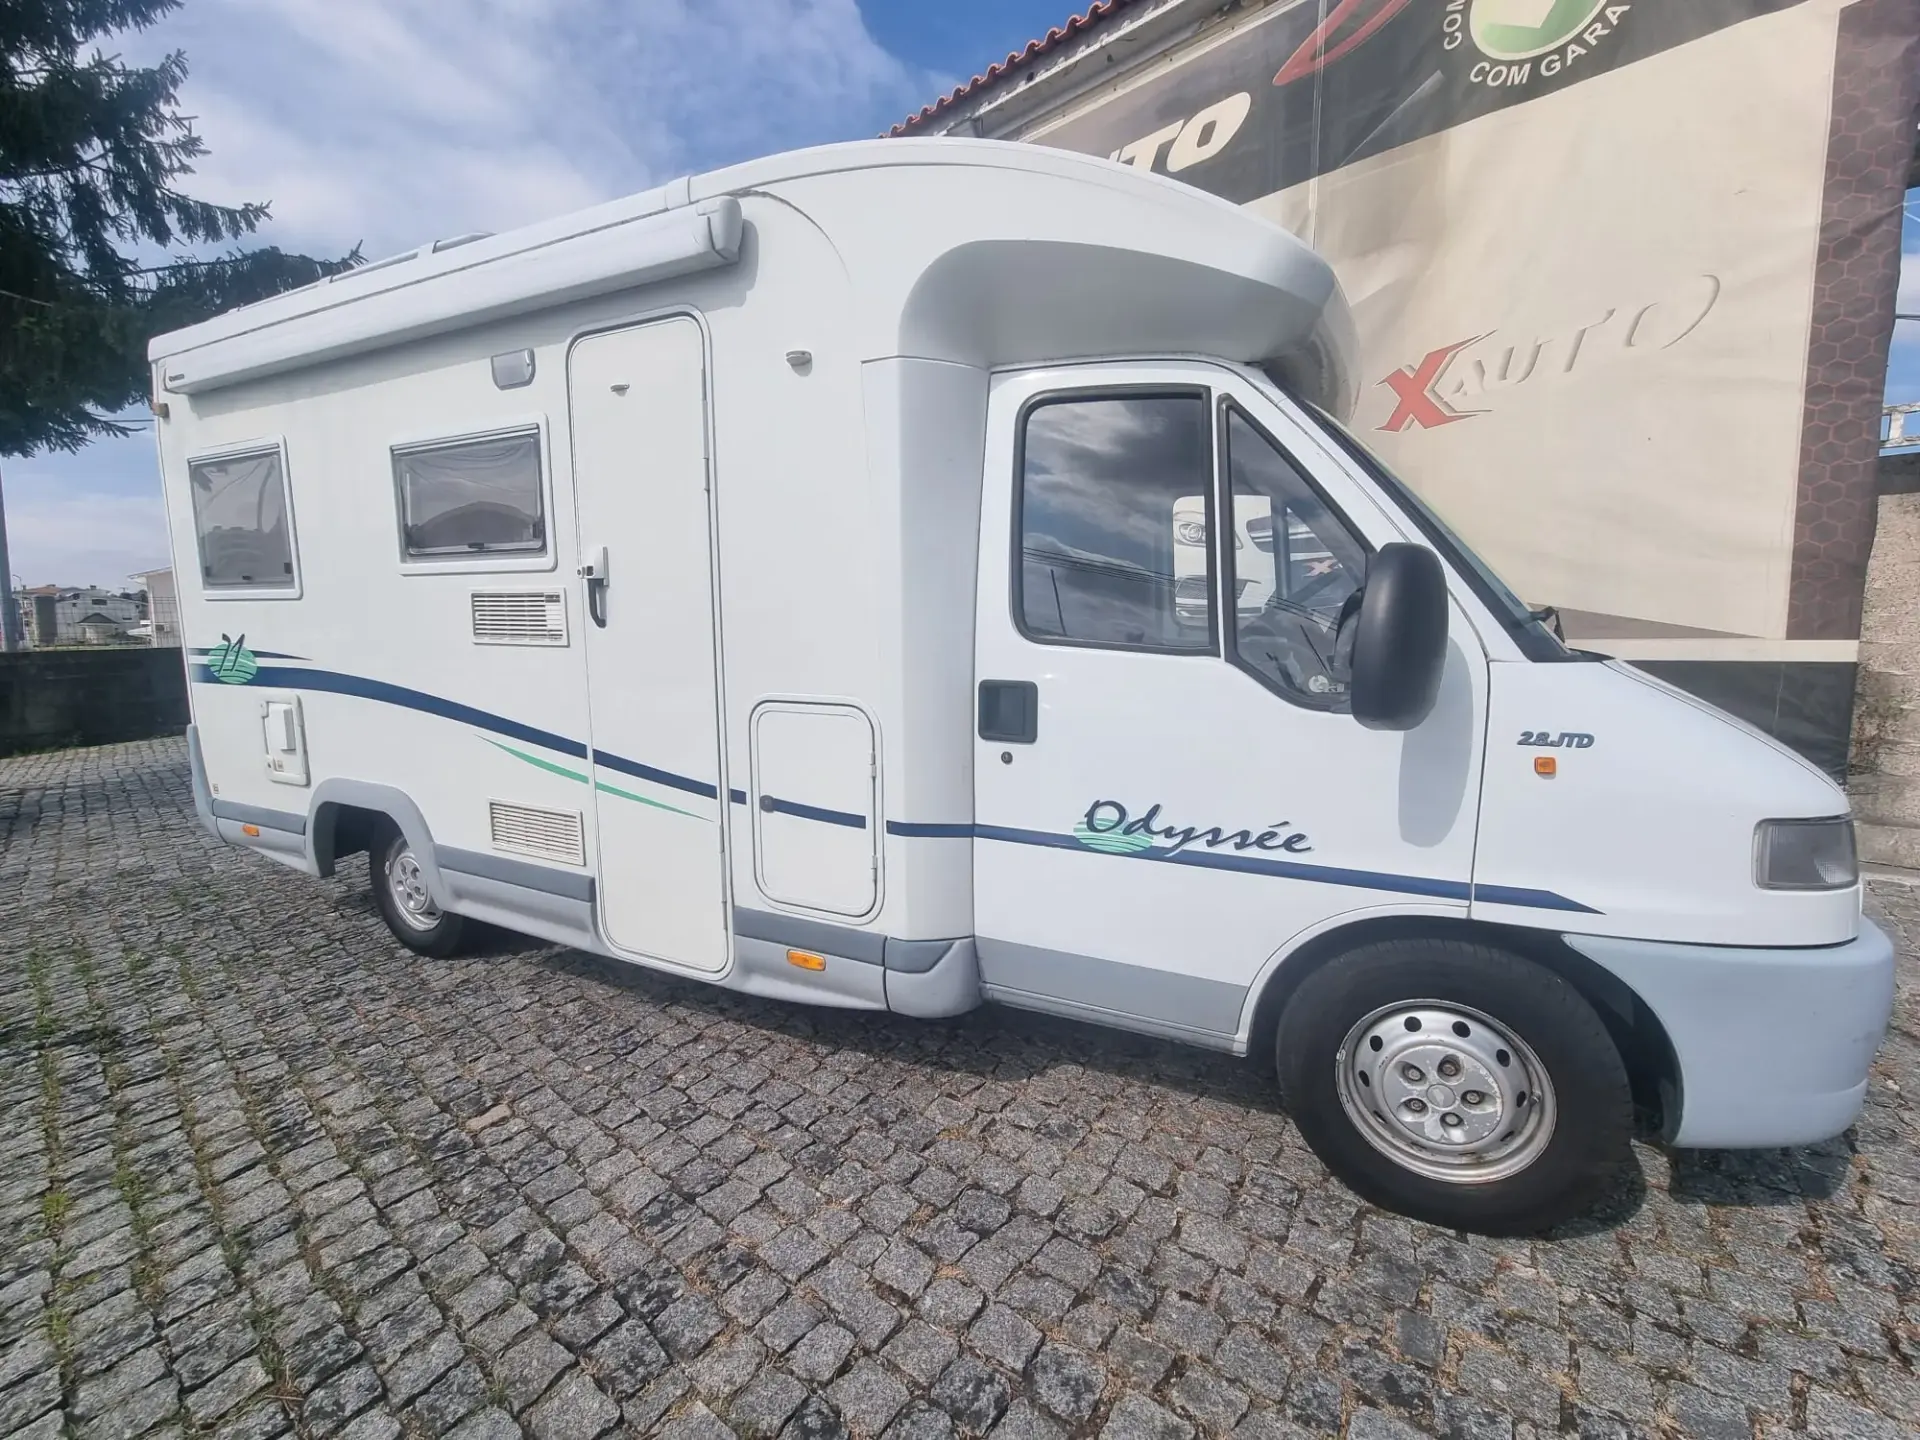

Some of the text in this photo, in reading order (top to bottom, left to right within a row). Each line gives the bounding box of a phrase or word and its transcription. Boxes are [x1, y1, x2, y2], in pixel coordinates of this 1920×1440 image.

[1469, 61, 1532, 87] COM
[1108, 91, 1252, 172] TO
[1084, 798, 1315, 858] Odyssée
